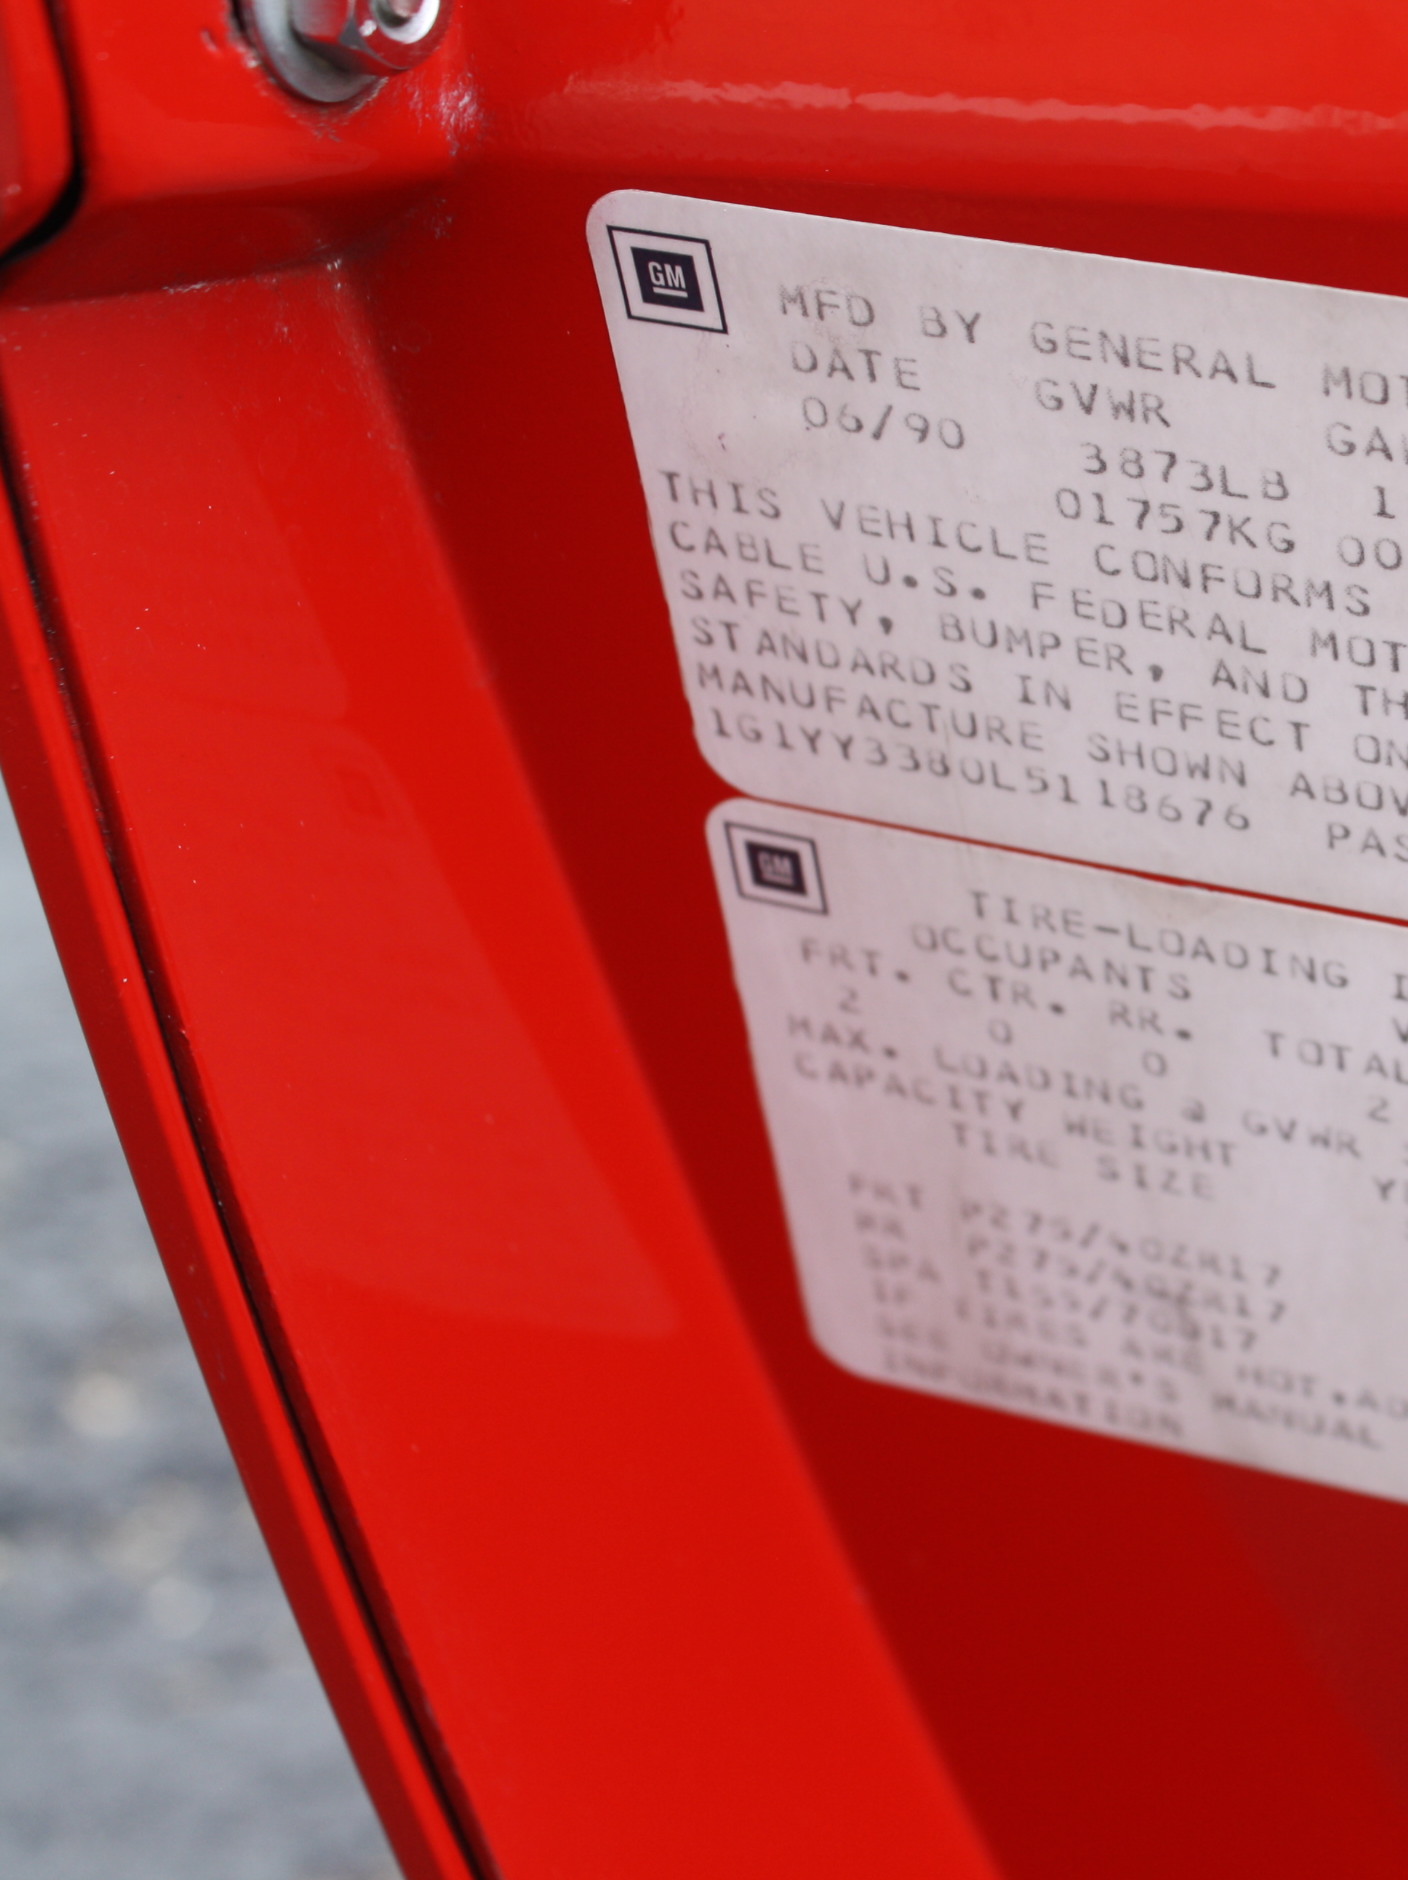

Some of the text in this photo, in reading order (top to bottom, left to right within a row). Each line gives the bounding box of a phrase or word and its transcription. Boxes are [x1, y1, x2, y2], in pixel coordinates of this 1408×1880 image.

[647, 262, 687, 290] GM
[780, 285, 876, 328] MFD
[921, 305, 982, 343] BY
[1031, 322, 1277, 388] GENERAL
[791, 343, 921, 391] DATE
[1034, 379, 1172, 427] GVWR
[803, 397, 966, 450] 06/90
[1082, 443, 1290, 501] 3873LB
[660, 470, 781, 520] THIS
[821, 498, 1050, 565] VEHICLE
[1094, 543, 1372, 617] CONFORMS
[1055, 487, 1297, 553] 01757KG
[670, 521, 825, 574] CABLE
[863, 557, 986, 601] U.S.
[1032, 582, 1267, 652] FEDERAL
[681, 570, 893, 634] SAFETY,
[940, 614, 1164, 681] BUMPER,
[1211, 660, 1309, 704] AND
[692, 620, 974, 693] STANDARDS
[1017, 675, 1072, 711] IN
[1115, 693, 1310, 751] EFFECT
[698, 663, 1044, 752] MANUFACTURE
[1088, 733, 1247, 788] SHOWN
[757, 855, 793, 879] GM
[801, 937, 912, 982] FRT.
[947, 968, 1066, 1017] CTR.
[1109, 1001, 1192, 1042] RR.
[910, 923, 1192, 1000] OCCUPANTS
[970, 891, 1350, 989] TIRE-LOADING
[787, 1014, 899, 1060] MAX.
[935, 1047, 1145, 1111] LOADING
[1242, 1110, 1363, 1159] GVWR
[838, 984, 861, 1015] 2
[1366, 1097, 1392, 1123] 2
[794, 1053, 1024, 1122] CAPACITY
[1064, 1112, 1238, 1169] WEIGHT
[953, 1121, 1060, 1169] TIRE
[1097, 1157, 1217, 1199] SIZE
[848, 1173, 924, 1211] FRT
